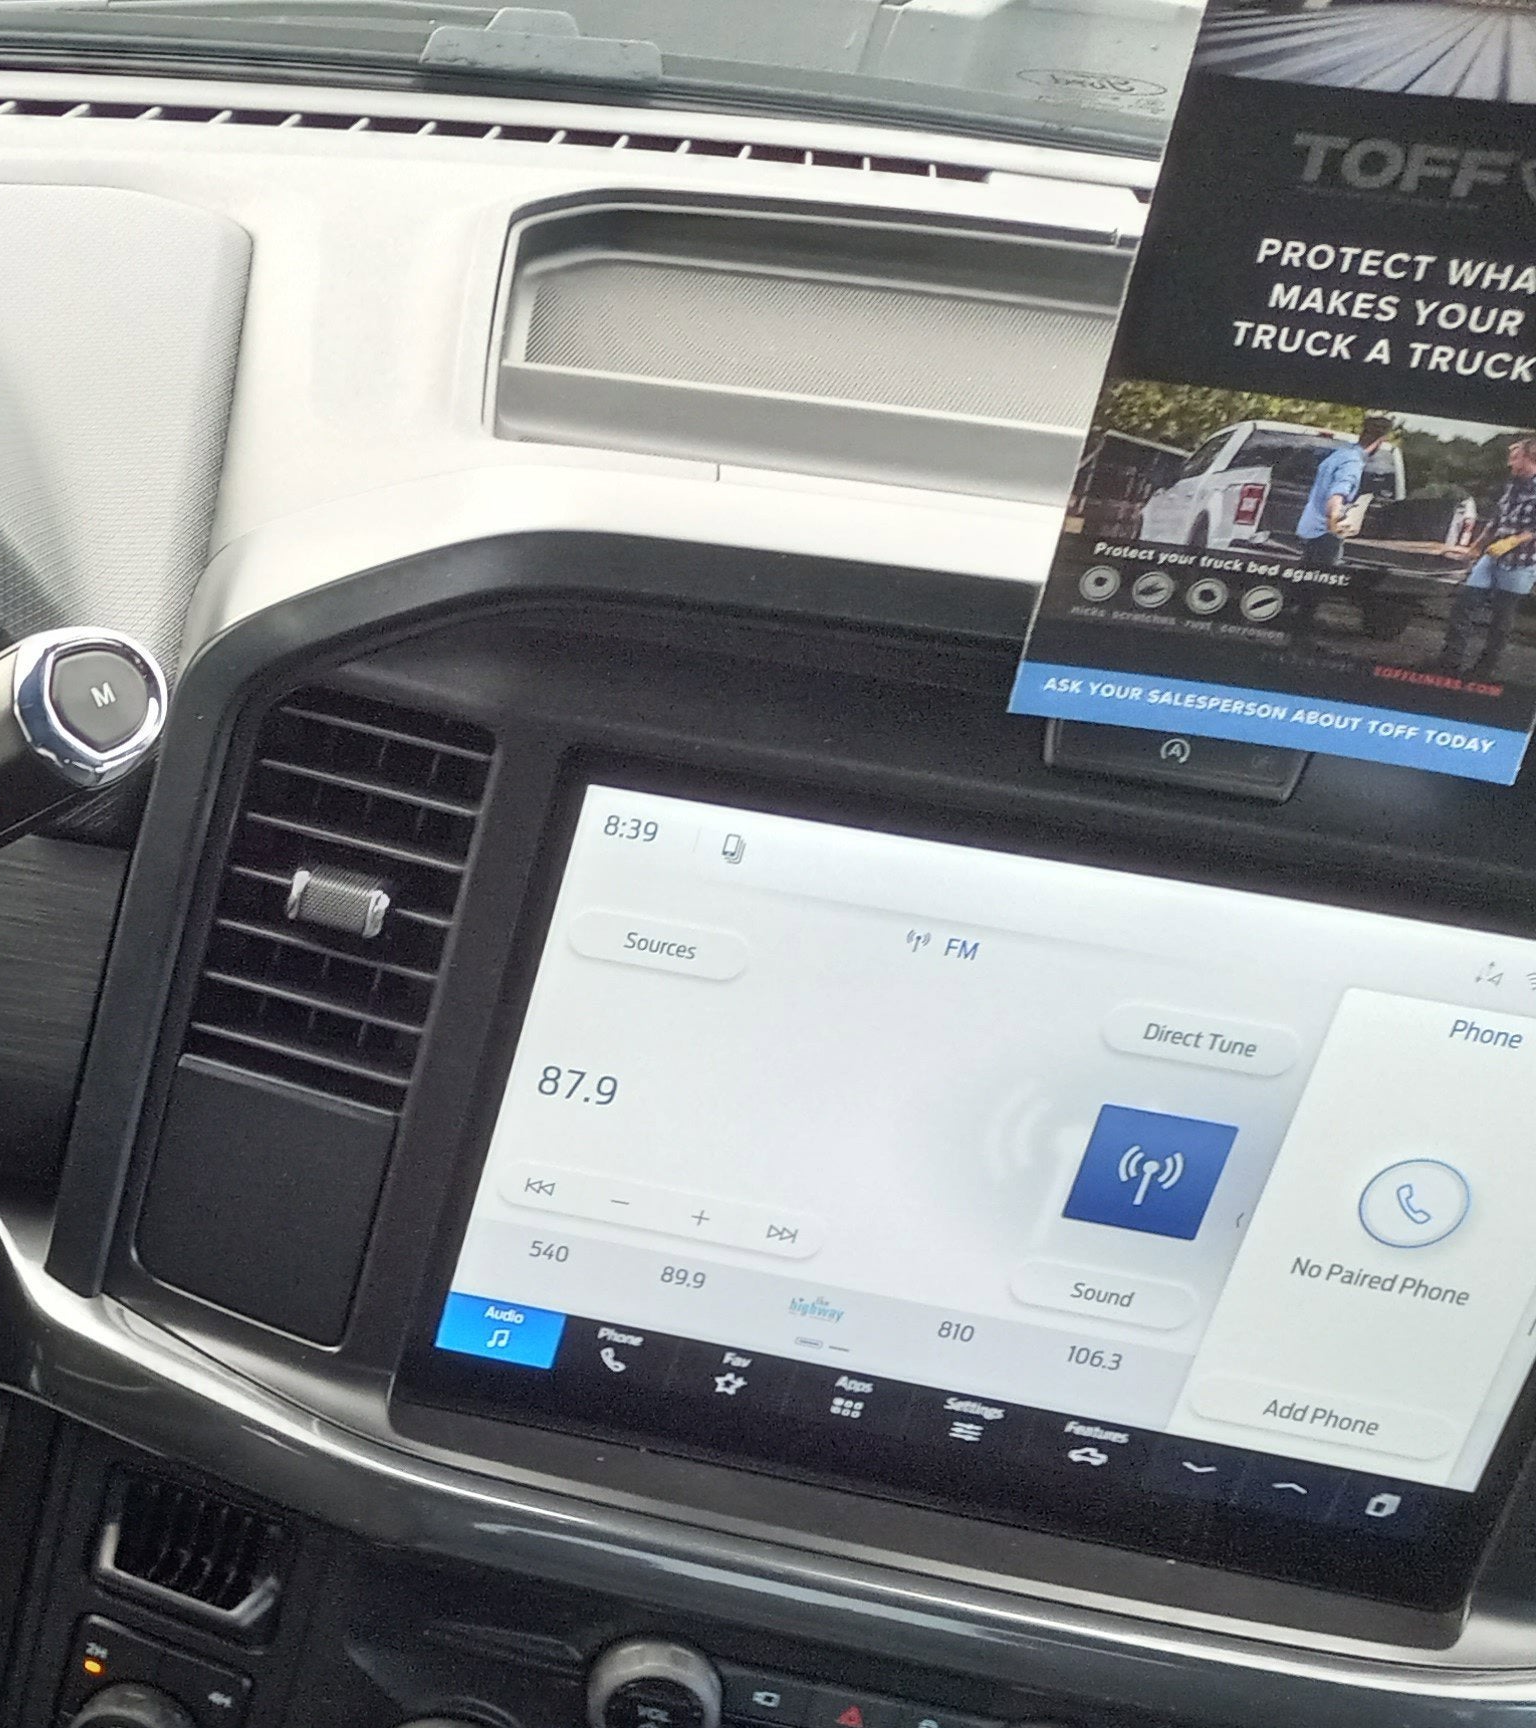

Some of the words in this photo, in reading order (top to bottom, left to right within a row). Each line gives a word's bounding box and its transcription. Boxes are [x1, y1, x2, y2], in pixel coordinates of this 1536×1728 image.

[1255, 237, 1438, 283] PROTECT
[1267, 282, 1401, 322] MAKES
[1414, 299, 1526, 338] YOUR
[1232, 320, 1358, 360] TRUCK
[1362, 337, 1392, 366] A
[1408, 341, 1536, 383] TRUCK
[1093, 541, 1156, 562] Protect
[1157, 551, 1197, 567] your
[1198, 554, 1243, 573] truck
[1246, 559, 1281, 577] bed
[1043, 677, 1085, 695] ASK
[1088, 681, 1144, 701] YOUR
[1146, 688, 1288, 721] SALESPERSON
[1289, 708, 1363, 732] ABOUT
[1367, 719, 1420, 741] TOFF
[1425, 729, 1497, 754] TODAY
[602, 813, 660, 844] 8:39
[622, 930, 697, 962] Sources
[943, 937, 981, 962] FM
[1142, 1021, 1204, 1051] Direct
[1206, 1032, 1258, 1059] Tune
[1448, 1018, 1524, 1051] Phone
[536, 1064, 619, 1107] 87.9
[528, 1239, 570, 1264] 540
[659, 1264, 707, 1291] 89.9
[1289, 1256, 1324, 1280] No
[1325, 1263, 1397, 1295] Paired
[1397, 1275, 1471, 1307] Phone
[1069, 1280, 1136, 1309] Sound
[483, 1305, 525, 1325] Audio
[596, 1325, 645, 1348] Phone
[936, 1319, 976, 1345] 810
[721, 1350, 754, 1369] Fav
[1065, 1344, 1124, 1372] 106.3
[833, 1374, 874, 1395] Apps
[942, 1395, 1006, 1422] Settings
[1262, 1398, 1308, 1424] Add
[1310, 1406, 1380, 1437] Phone
[1063, 1419, 1130, 1445] Features
